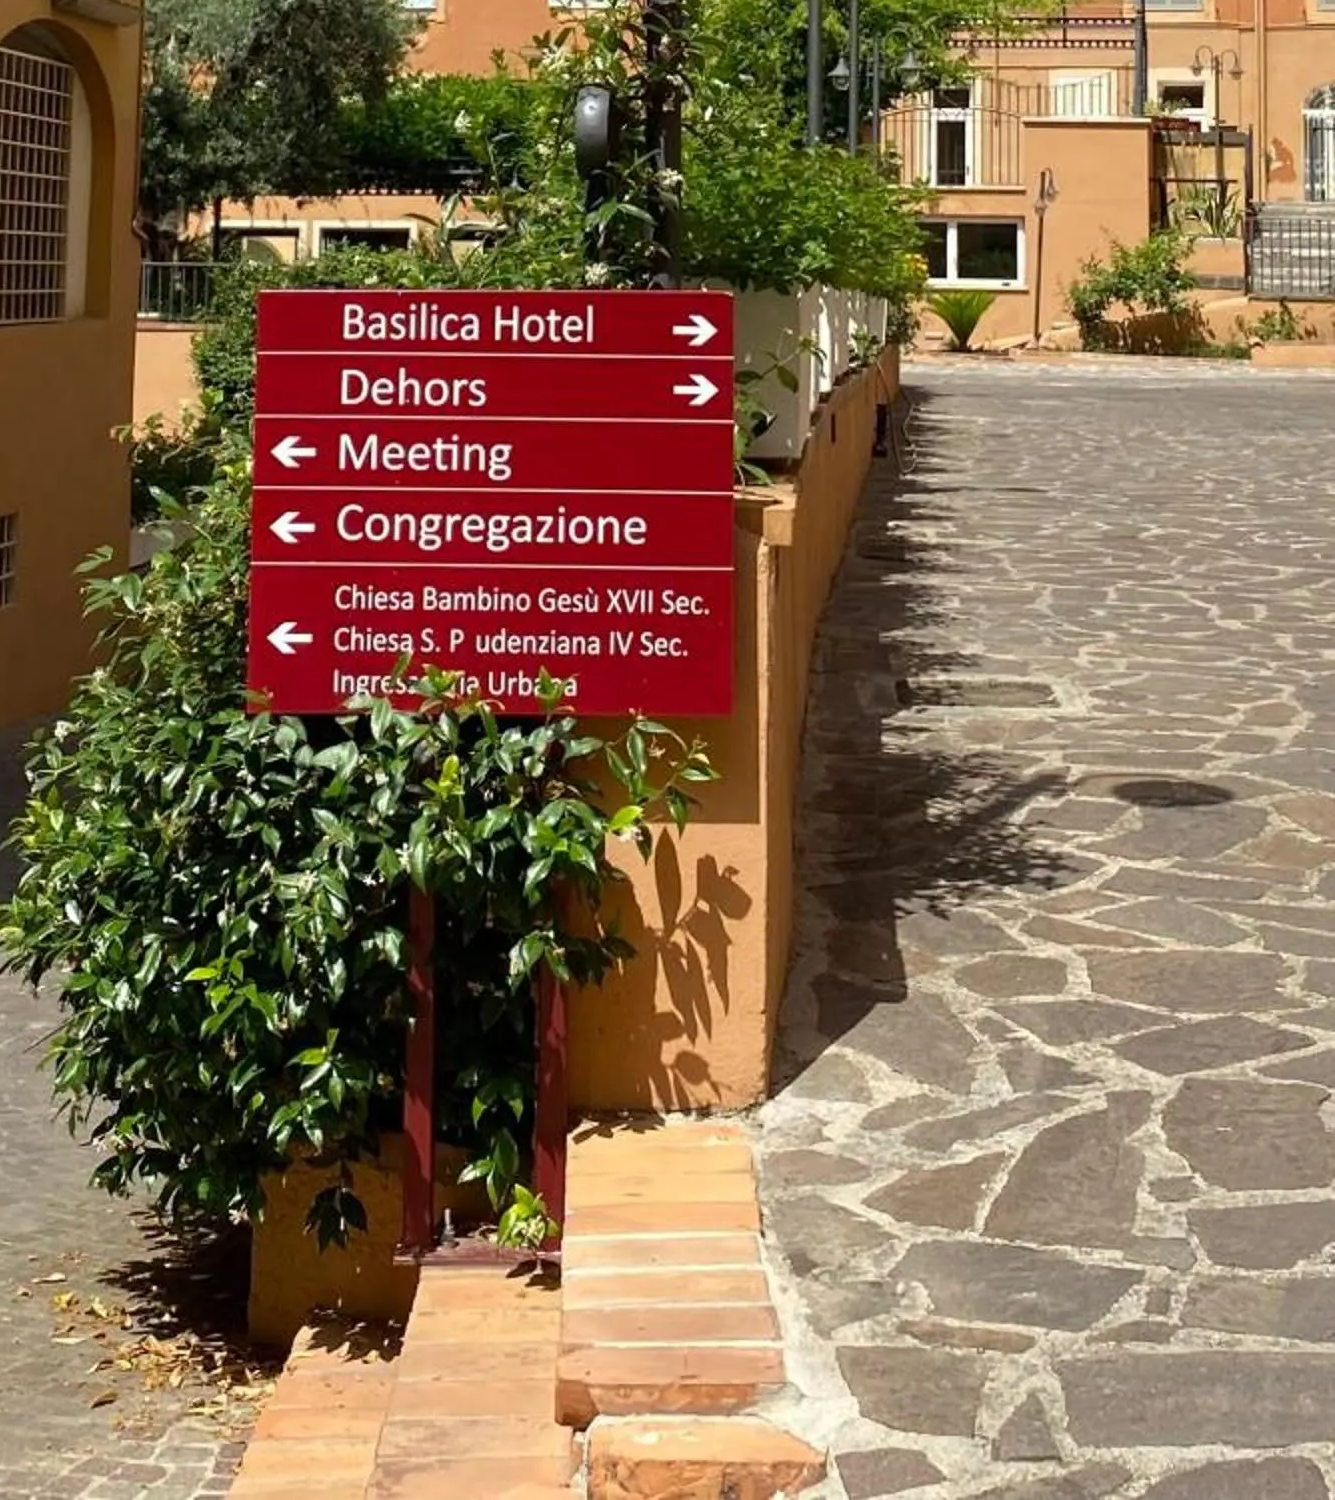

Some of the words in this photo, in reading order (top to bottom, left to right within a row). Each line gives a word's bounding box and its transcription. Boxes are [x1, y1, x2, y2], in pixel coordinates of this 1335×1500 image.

[342, 302, 480, 341] Basilica
[494, 304, 594, 343] Hotel
[340, 367, 487, 407] Dehors
[338, 433, 513, 481] Meeting
[336, 503, 648, 553] Congregazione
[334, 584, 414, 611] Chiesa
[422, 585, 531, 612] Bambino
[538, 587, 599, 614] Gesù
[606, 589, 654, 614] XVII
[661, 589, 711, 616] Sec.
[334, 626, 413, 652] Chiesa
[420, 627, 441, 653] S.
[609, 631, 635, 656] IV
[640, 631, 689, 657] Sec.
